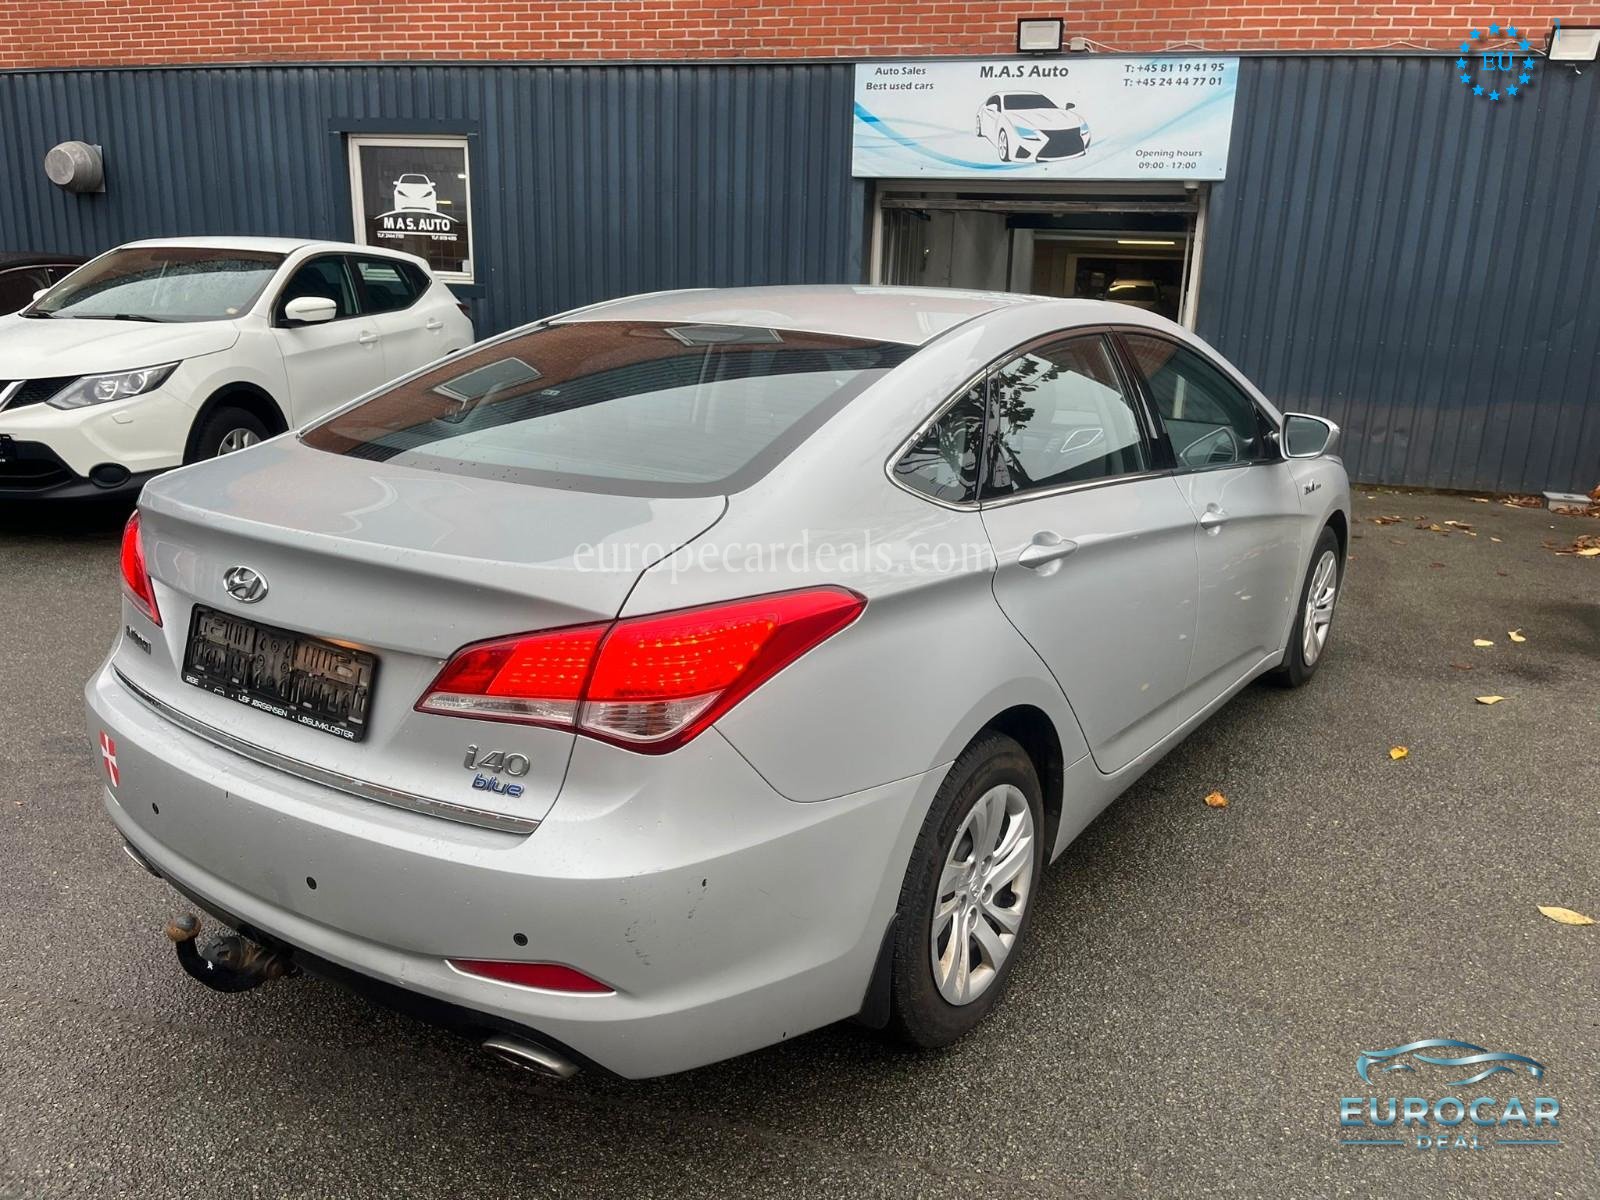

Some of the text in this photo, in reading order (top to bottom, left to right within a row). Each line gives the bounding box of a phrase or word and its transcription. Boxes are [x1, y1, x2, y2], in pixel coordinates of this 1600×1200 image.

[875, 66, 926, 75] Auto Sales
[980, 65, 1069, 78] M.A.S Auto
[1125, 63, 1224, 72] T: +45 81 19 41 95
[866, 82, 887, 90] Best
[889, 82, 912, 90] used
[1136, 78, 1155, 86] +45
[1159, 78, 1173, 86] 24
[1175, 77, 1189, 86] 44
[1192, 77, 1206, 86] 77
[1209, 77, 1222, 86] 01
[1135, 149, 1202, 159] Opening hours
[1138, 161, 1164, 169] 09:00
[1172, 161, 1197, 169] 17:00
[418, 219, 450, 231] AUTO
[463, 743, 531, 777] i40
[471, 772, 526, 798] blue
